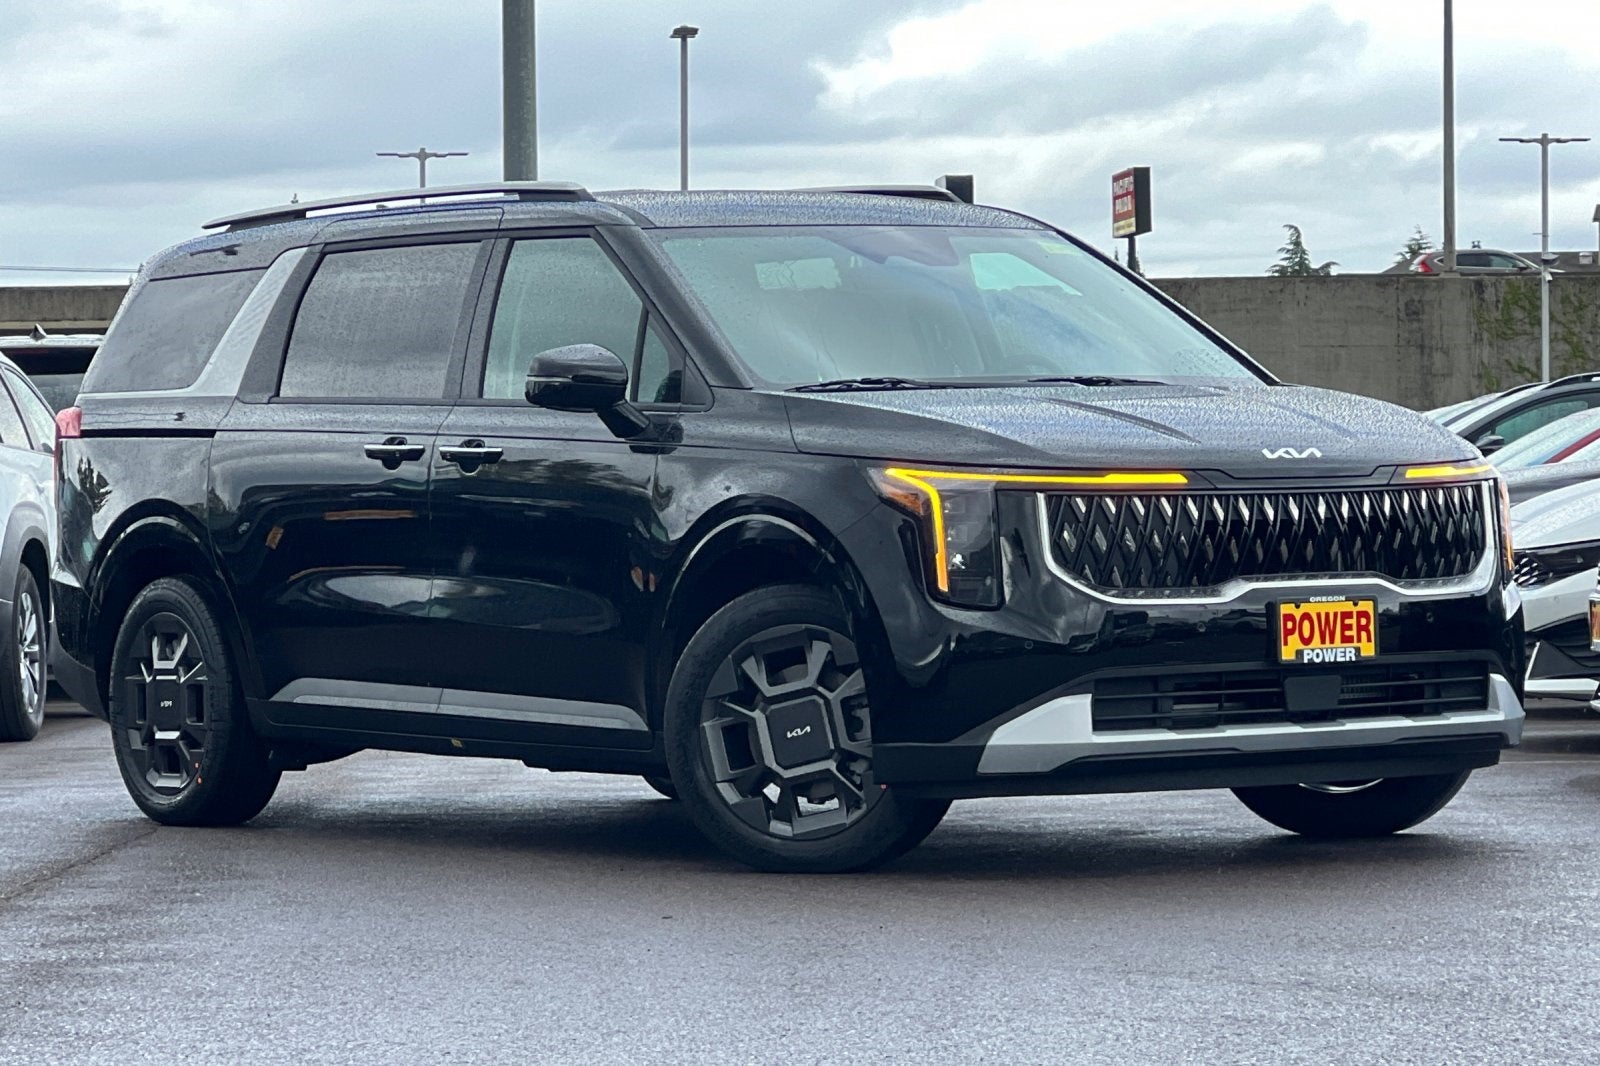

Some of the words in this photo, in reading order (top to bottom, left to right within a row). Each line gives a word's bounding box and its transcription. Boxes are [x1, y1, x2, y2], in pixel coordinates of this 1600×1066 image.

[1261, 447, 1323, 459] KIA
[1282, 610, 1372, 647] POWER
[1303, 647, 1356, 663] POWER
